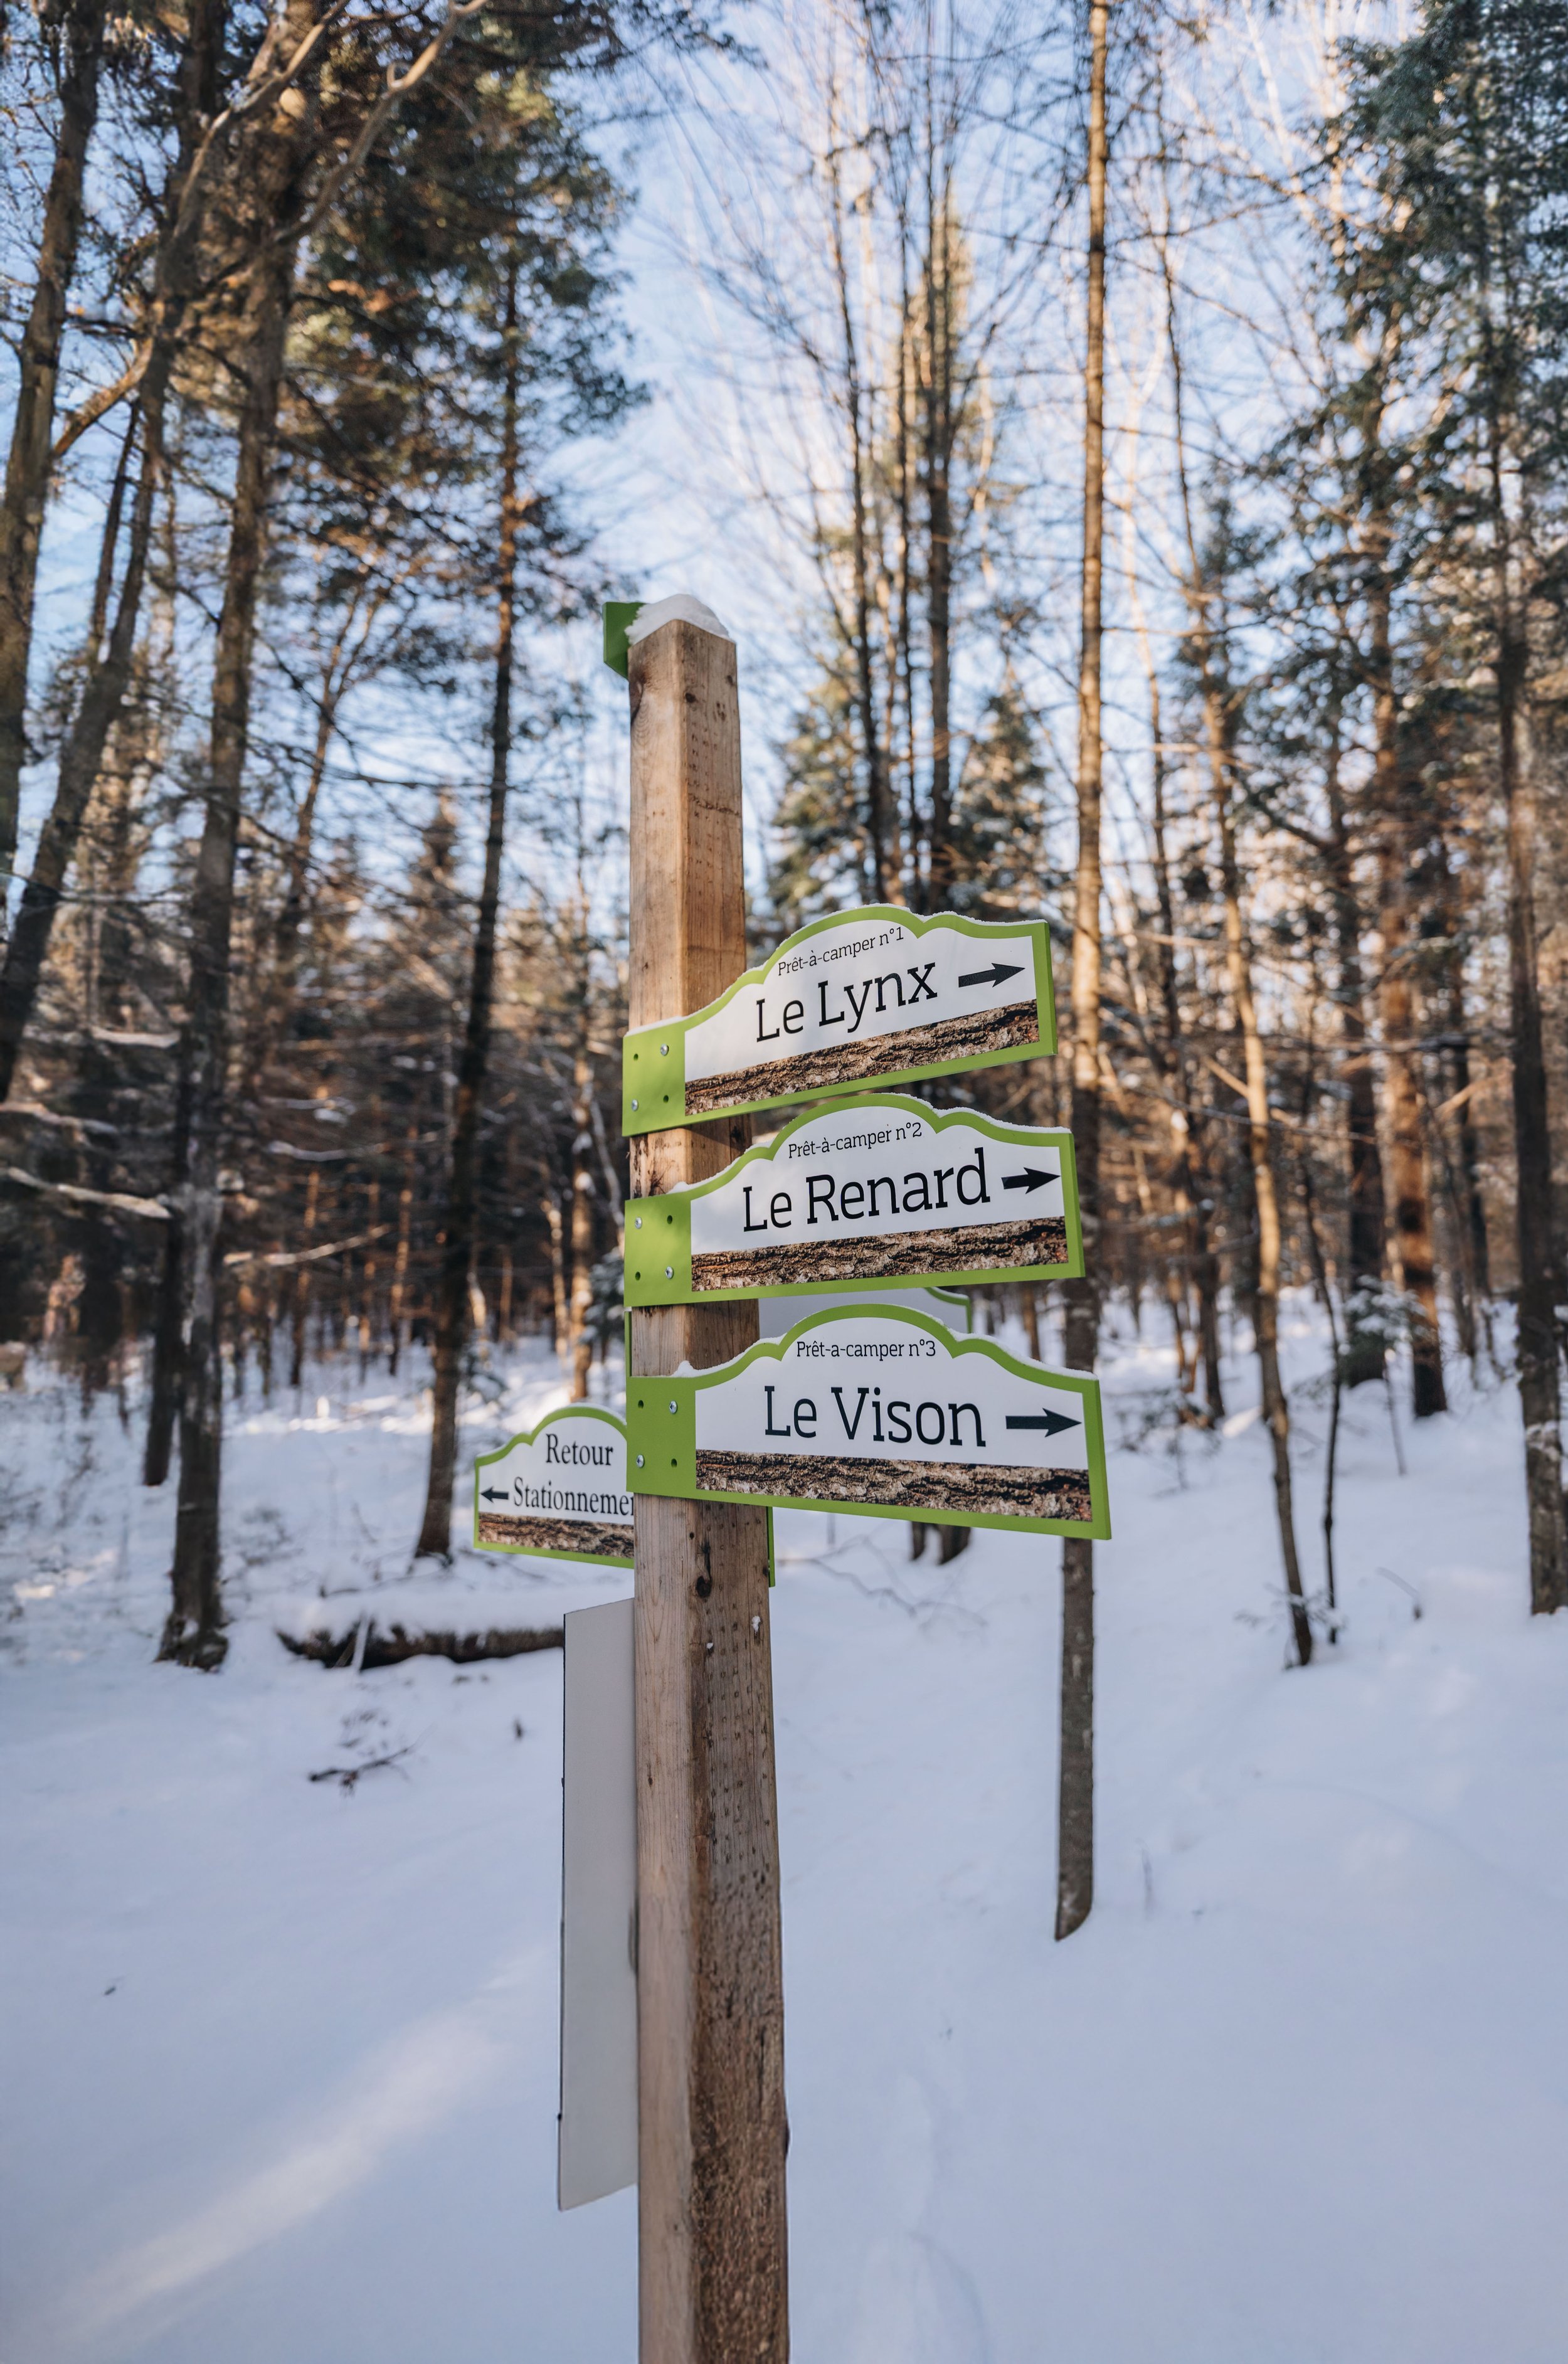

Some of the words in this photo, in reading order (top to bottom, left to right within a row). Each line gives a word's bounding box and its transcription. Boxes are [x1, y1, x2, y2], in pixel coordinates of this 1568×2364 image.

[778, 937, 876, 976] Prêt-à-camper
[879, 926, 904, 946] n°1
[756, 998, 805, 1043] Le
[817, 962, 938, 1034] Lynx
[788, 1130, 892, 1159] Prêt-à-camper
[895, 1121, 922, 1141] n°2
[743, 1185, 792, 1232] Le
[805, 1147, 991, 1226] Renard
[797, 1340, 905, 1362] Prêt-a-camper
[908, 1338, 936, 1357] n°3
[764, 1385, 817, 1439] Le
[830, 1386, 987, 1448] Vison
[546, 1433, 614, 1466] Retour
